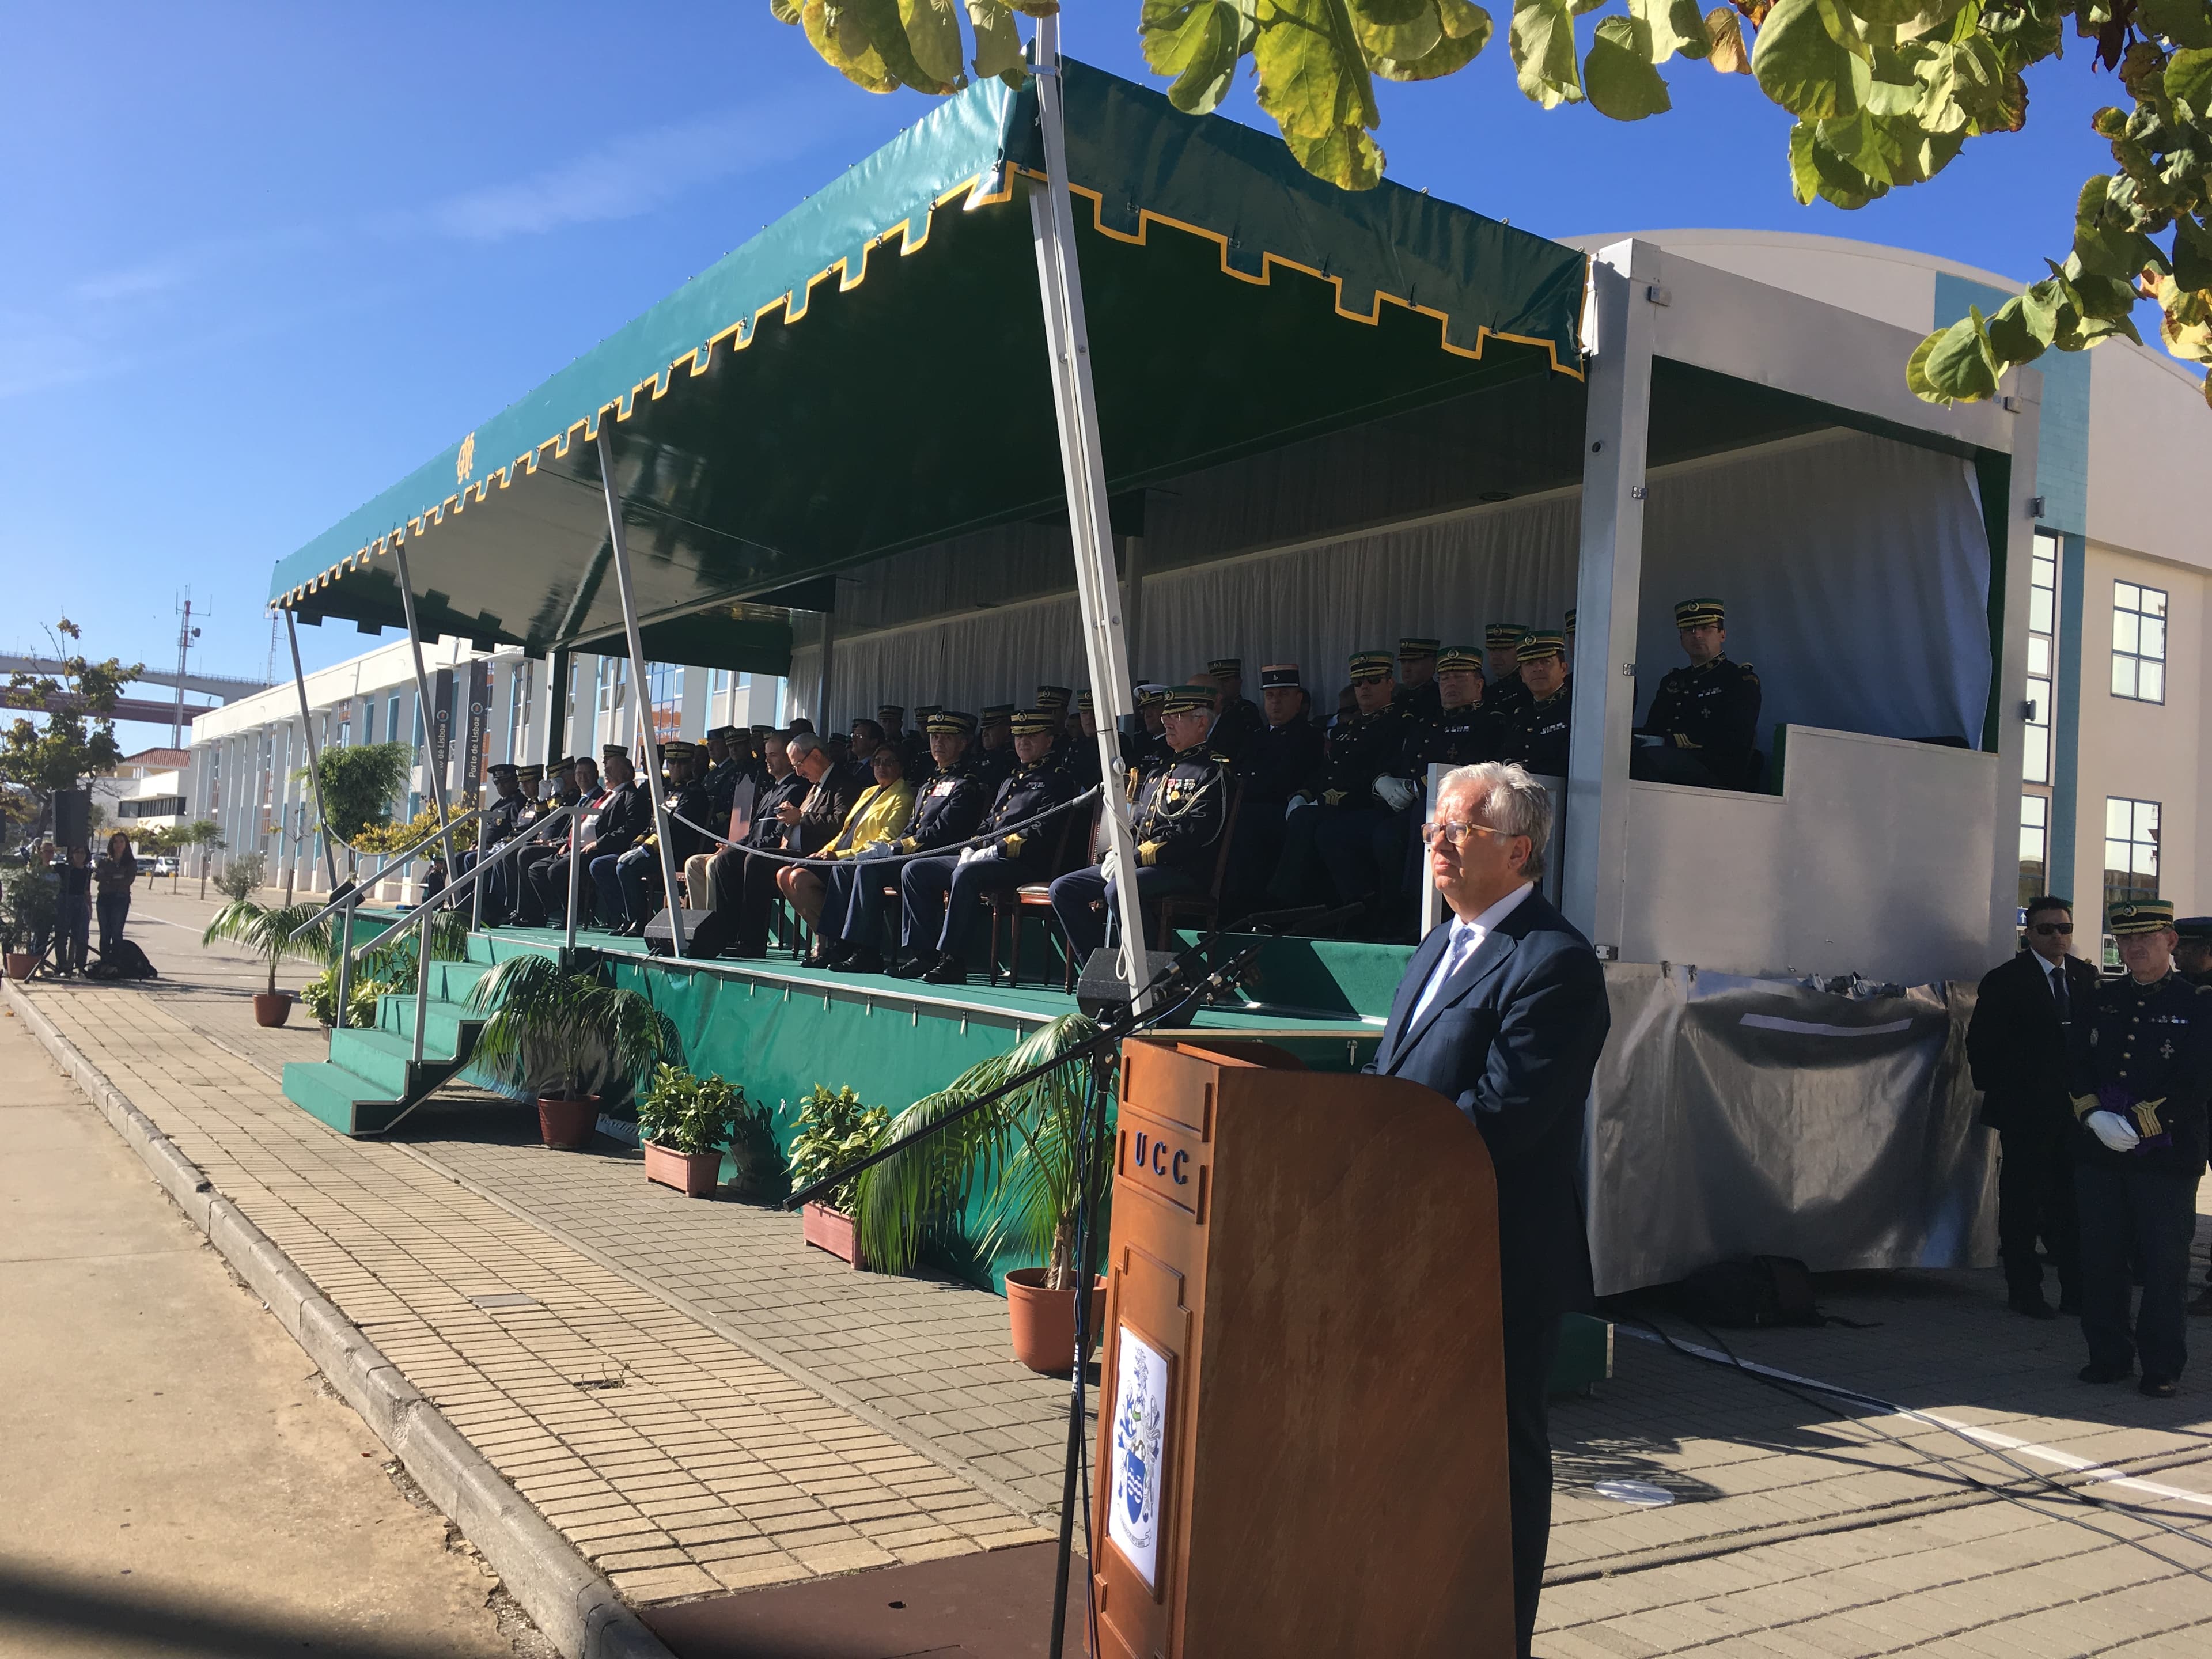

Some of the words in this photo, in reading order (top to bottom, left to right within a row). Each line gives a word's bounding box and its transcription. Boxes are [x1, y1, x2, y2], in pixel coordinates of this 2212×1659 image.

[437, 724, 446, 748] Lisboa
[471, 717, 480, 743] Lisboa
[471, 744, 478, 755] de
[468, 756, 478, 778] Porto
[1135, 1131, 1189, 1185] UCC
